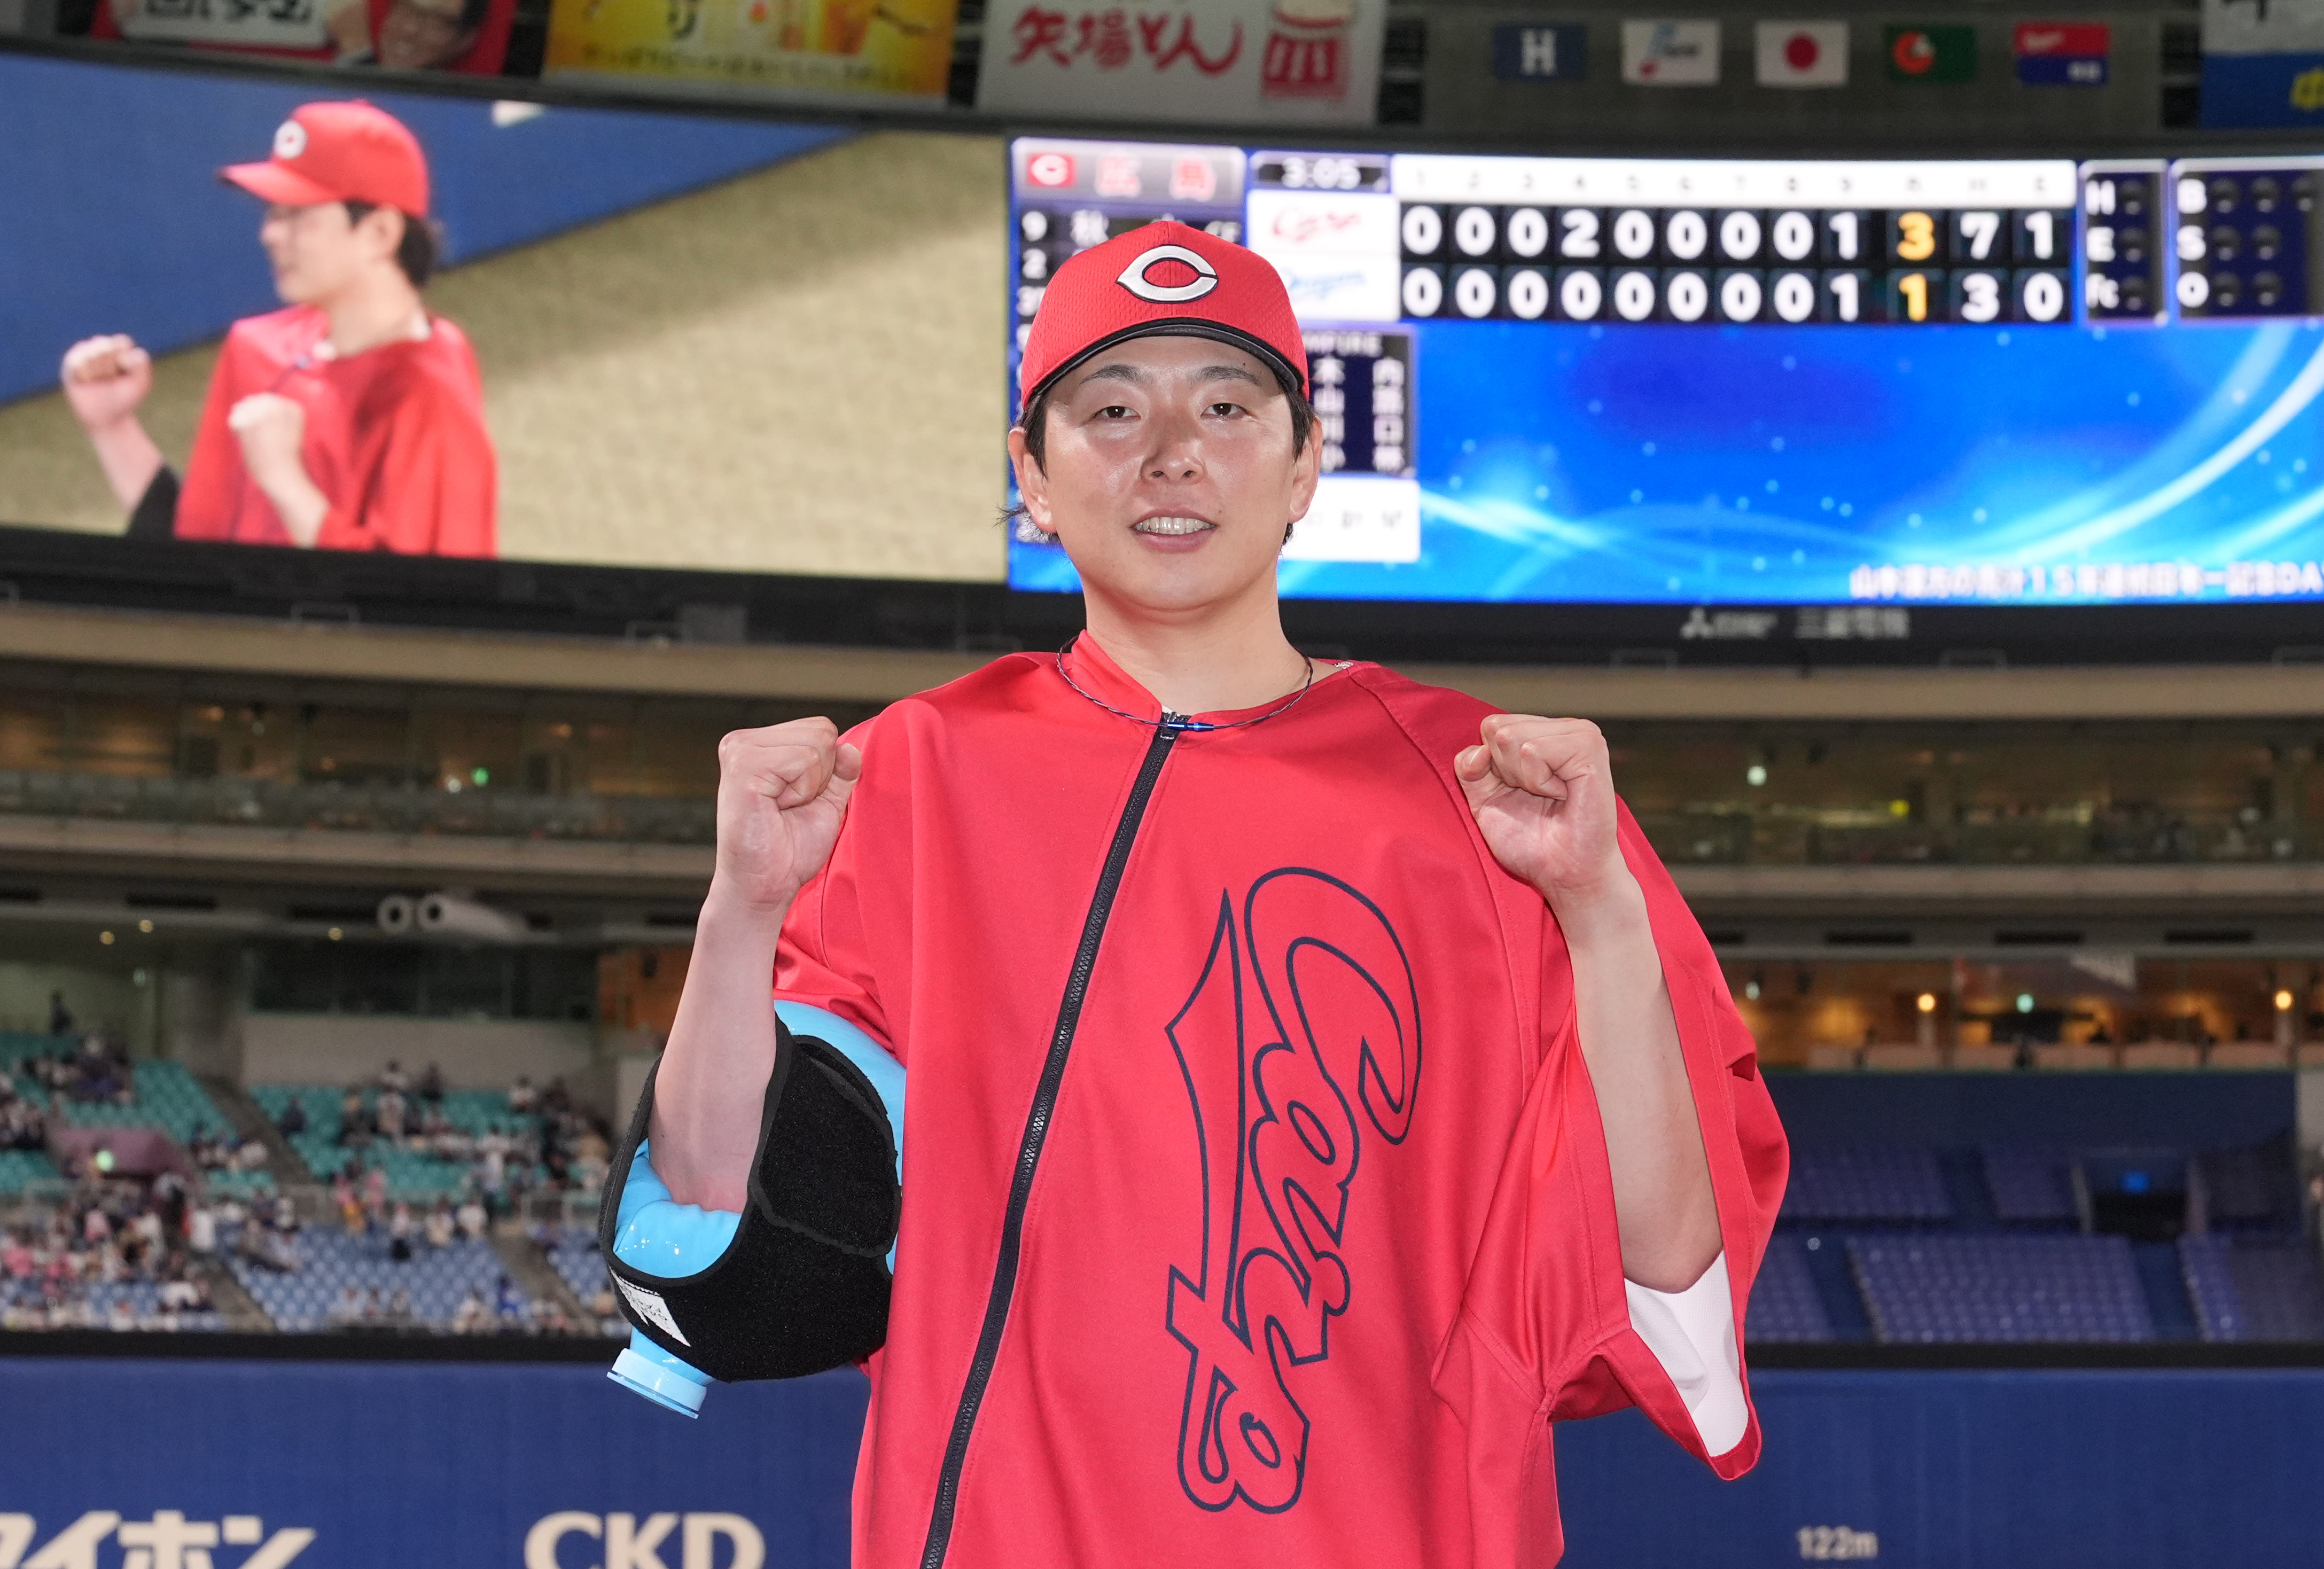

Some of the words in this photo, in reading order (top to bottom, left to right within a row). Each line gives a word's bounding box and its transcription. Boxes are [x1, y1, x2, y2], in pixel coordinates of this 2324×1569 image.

[1011, 6, 1243, 75] 矢場とん
[1520, 29, 1556, 75] H
[1401, 205, 1441, 254] 0
[1455, 207, 1495, 255] 0
[1508, 208, 1548, 256] 0
[1562, 209, 1599, 257] 2
[1614, 210, 1654, 258] 0
[1667, 210, 1707, 259] 0
[1721, 211, 1760, 259] 0
[1774, 212, 1813, 260] 0
[1830, 212, 1857, 259] 1
[1897, 212, 1935, 260] 3
[1960, 212, 1999, 259] 7
[2025, 211, 2053, 259] 1
[1116, 244, 1220, 305] C
[1402, 267, 1442, 317] 0
[1456, 269, 1495, 317] 0
[1508, 270, 1548, 318] 0
[1561, 271, 1601, 319] 0
[1615, 271, 1655, 321] 0
[1668, 272, 1707, 321] 0
[1721, 273, 1761, 321] 0
[1774, 273, 1814, 322] 0
[1830, 274, 1858, 321] 1
[1899, 274, 1927, 321] 1
[1962, 273, 1999, 322] 3
[2024, 272, 2063, 321] 0
[2176, 271, 2209, 308] O
[1165, 867, 1422, 1515] Carp
[524, 1510, 766, 1569] CKD
